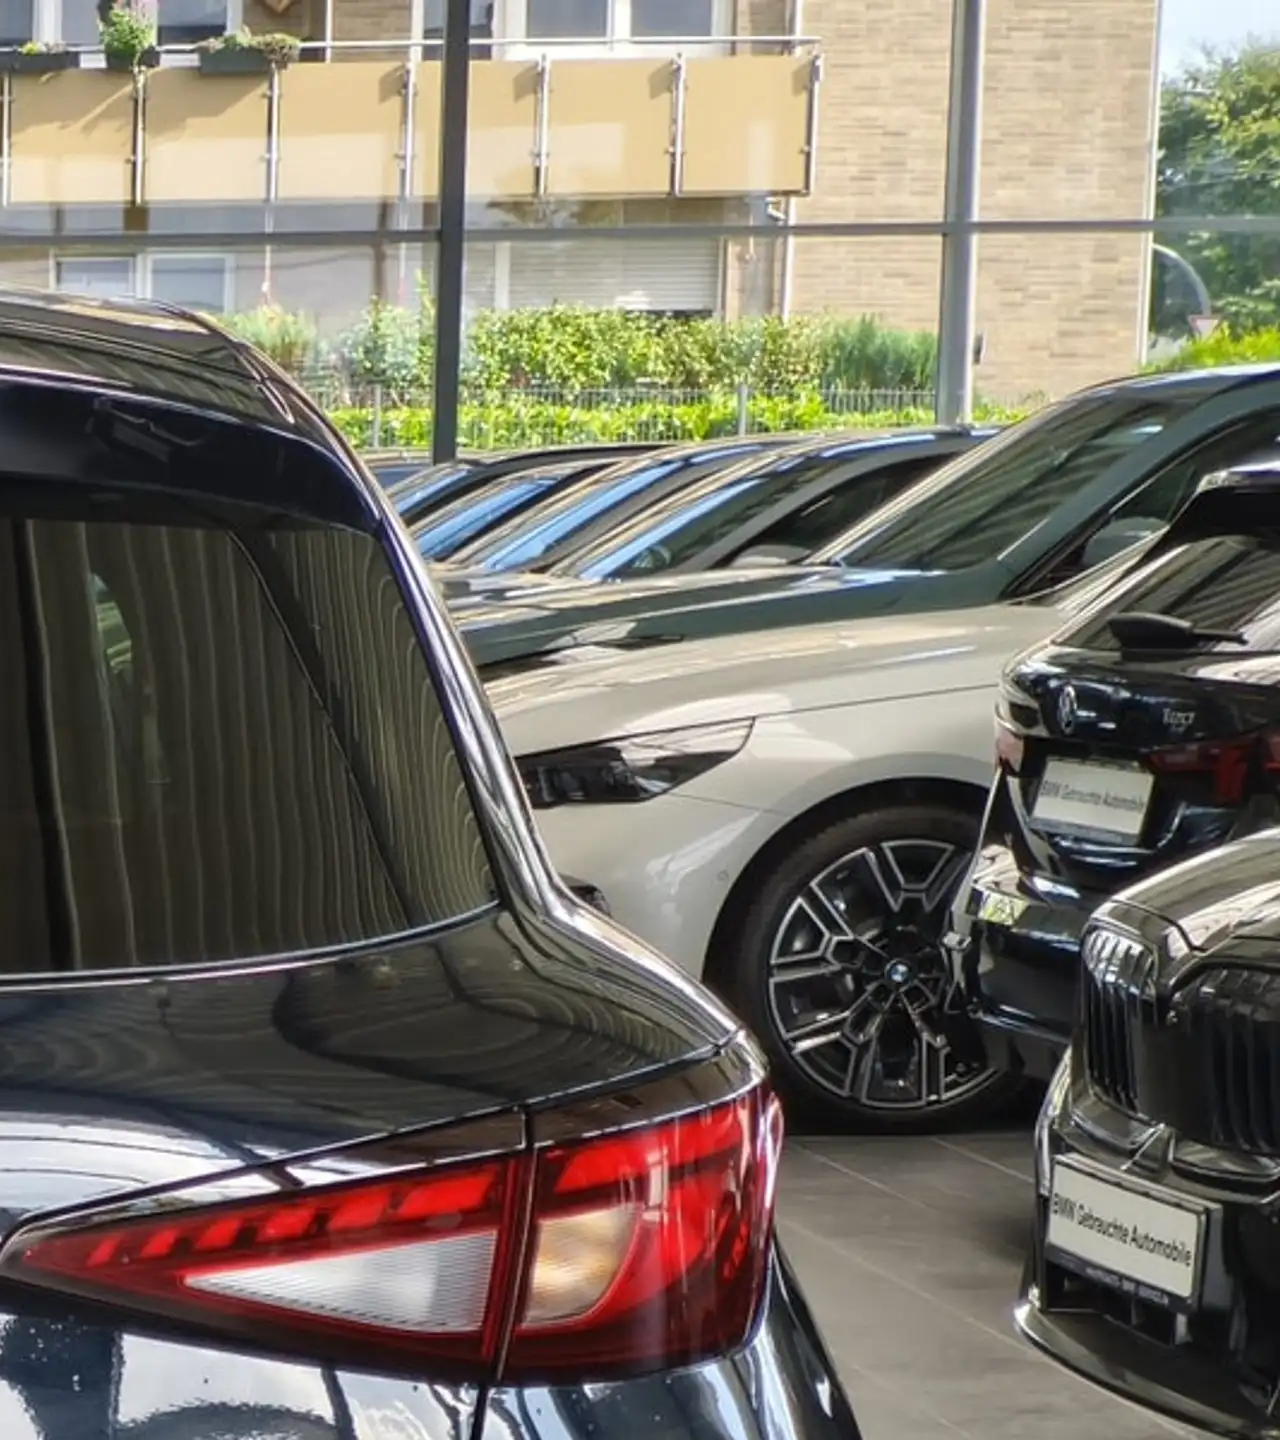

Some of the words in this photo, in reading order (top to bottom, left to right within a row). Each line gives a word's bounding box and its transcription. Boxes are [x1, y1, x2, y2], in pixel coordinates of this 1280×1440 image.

[1053, 1192, 1076, 1222] BMW
[1077, 1203, 1129, 1245] Gebrauchte
[1129, 1225, 1192, 1267] Automobile
